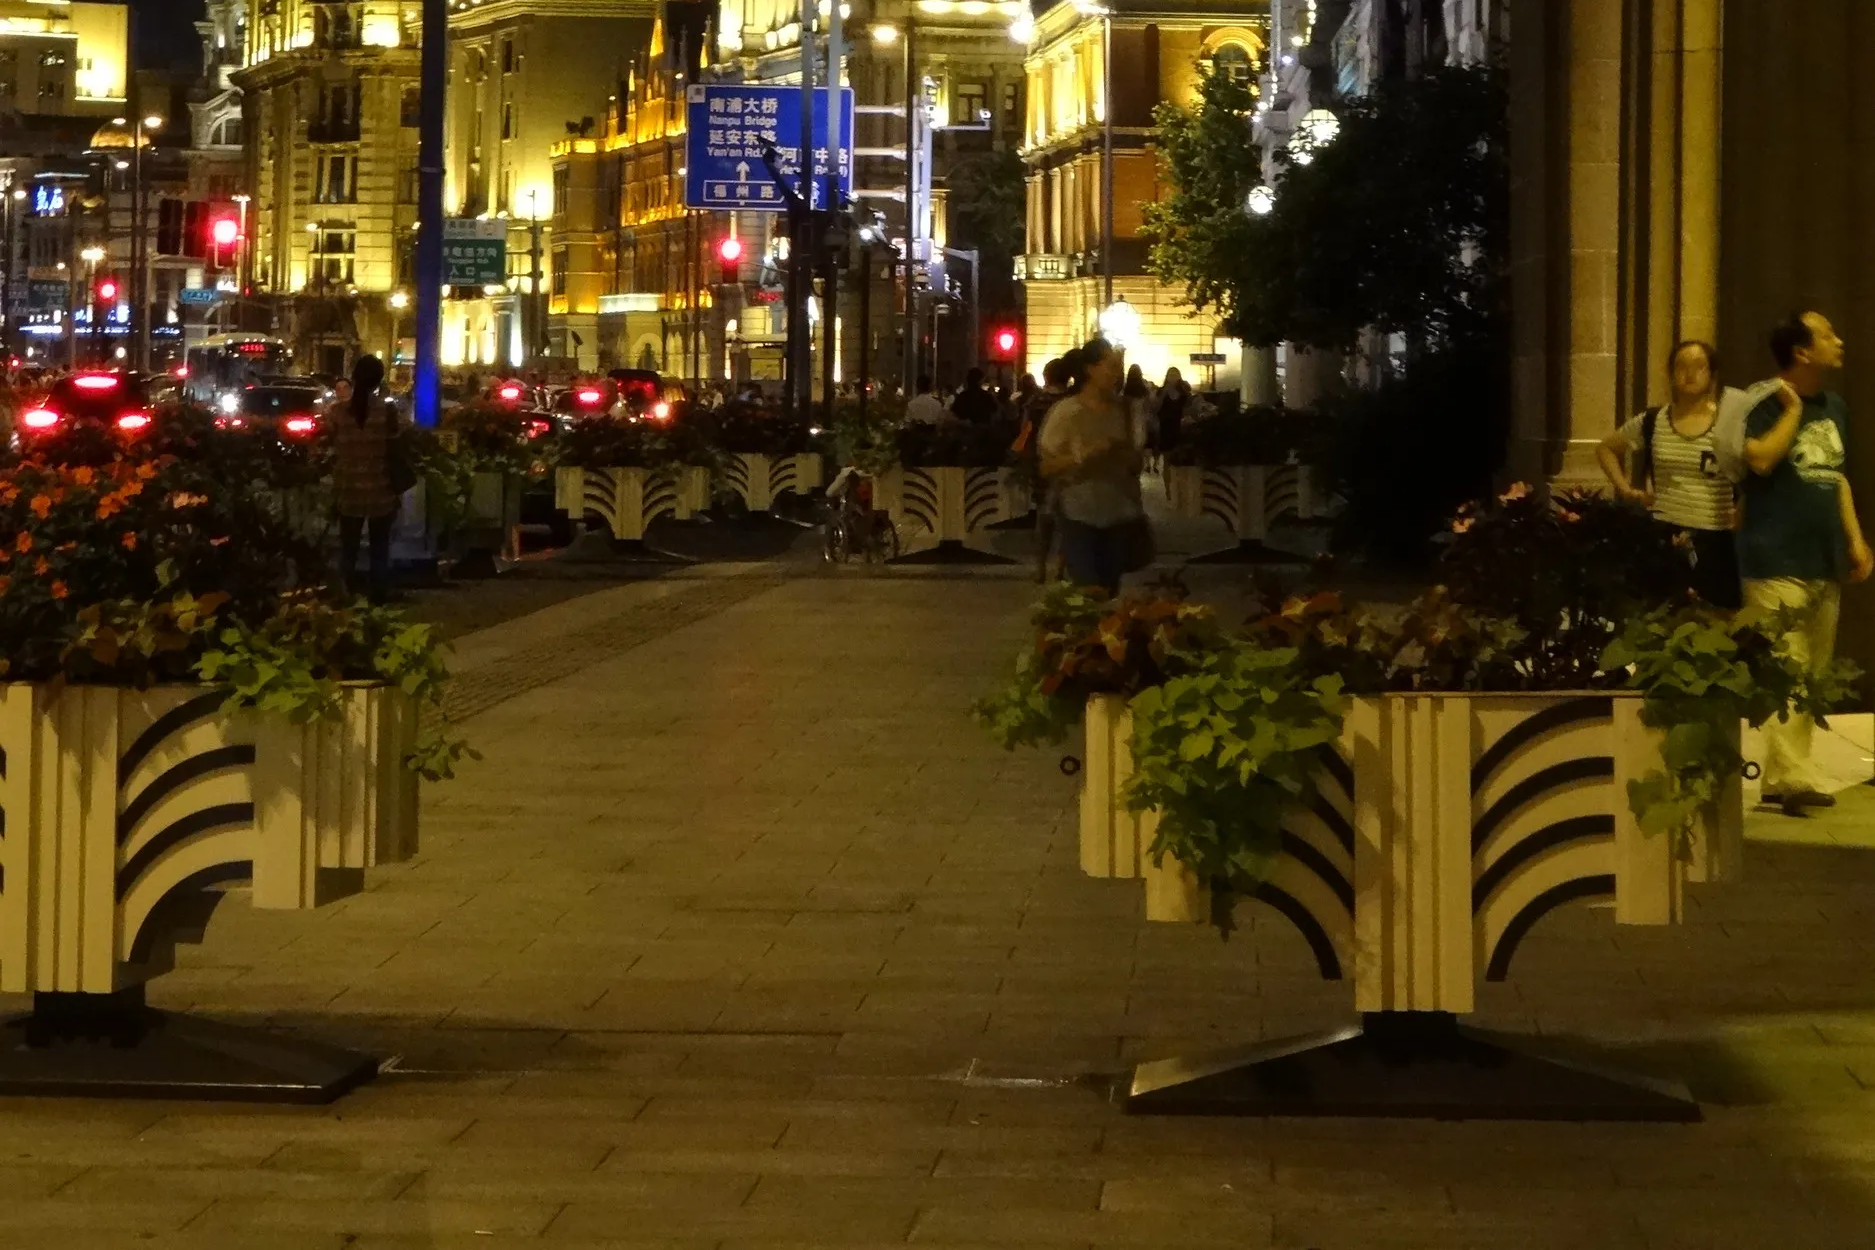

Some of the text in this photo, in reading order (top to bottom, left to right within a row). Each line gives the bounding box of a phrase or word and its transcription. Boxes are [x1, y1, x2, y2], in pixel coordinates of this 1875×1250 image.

[709, 97, 778, 114] 南浦大桥
[708, 116, 778, 127] Nanpu Bridge
[708, 129, 777, 145] 延安东路
[713, 184, 774, 199] 福州路
